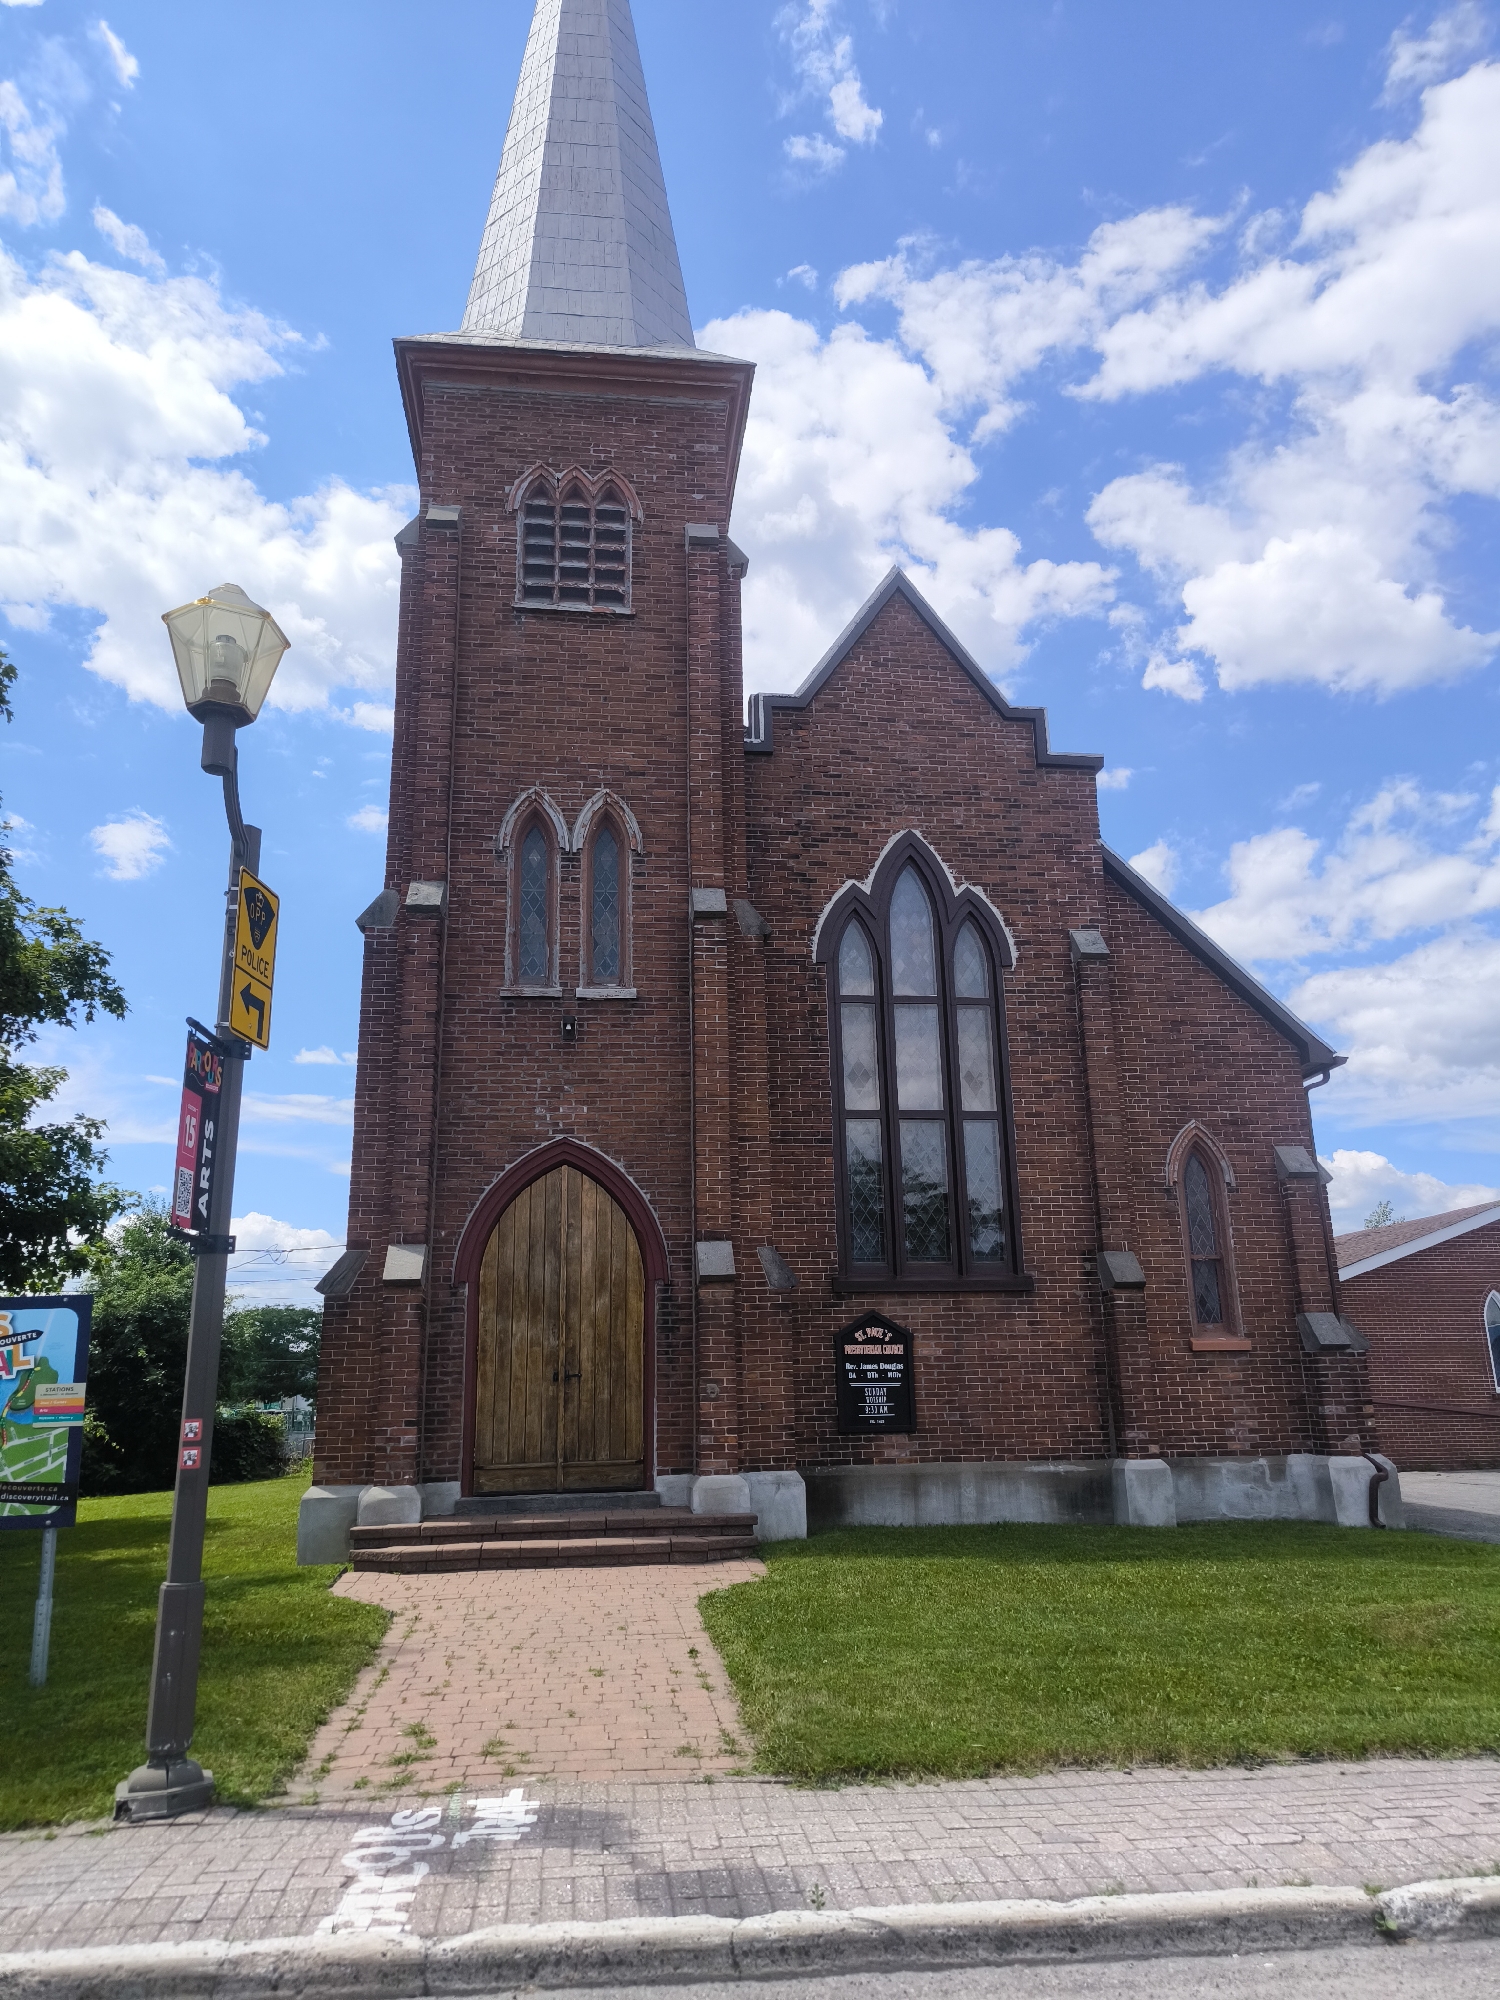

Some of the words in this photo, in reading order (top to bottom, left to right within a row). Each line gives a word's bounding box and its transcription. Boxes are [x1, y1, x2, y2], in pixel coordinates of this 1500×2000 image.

[241, 944, 269, 979] POLICE
[185, 1115, 196, 1148] 15
[198, 1119, 214, 1218] ARTS
[882, 1344, 904, 1355] CHURCH
[864, 1388, 887, 1396] SUNDAY
[879, 1406, 889, 1414] AM
